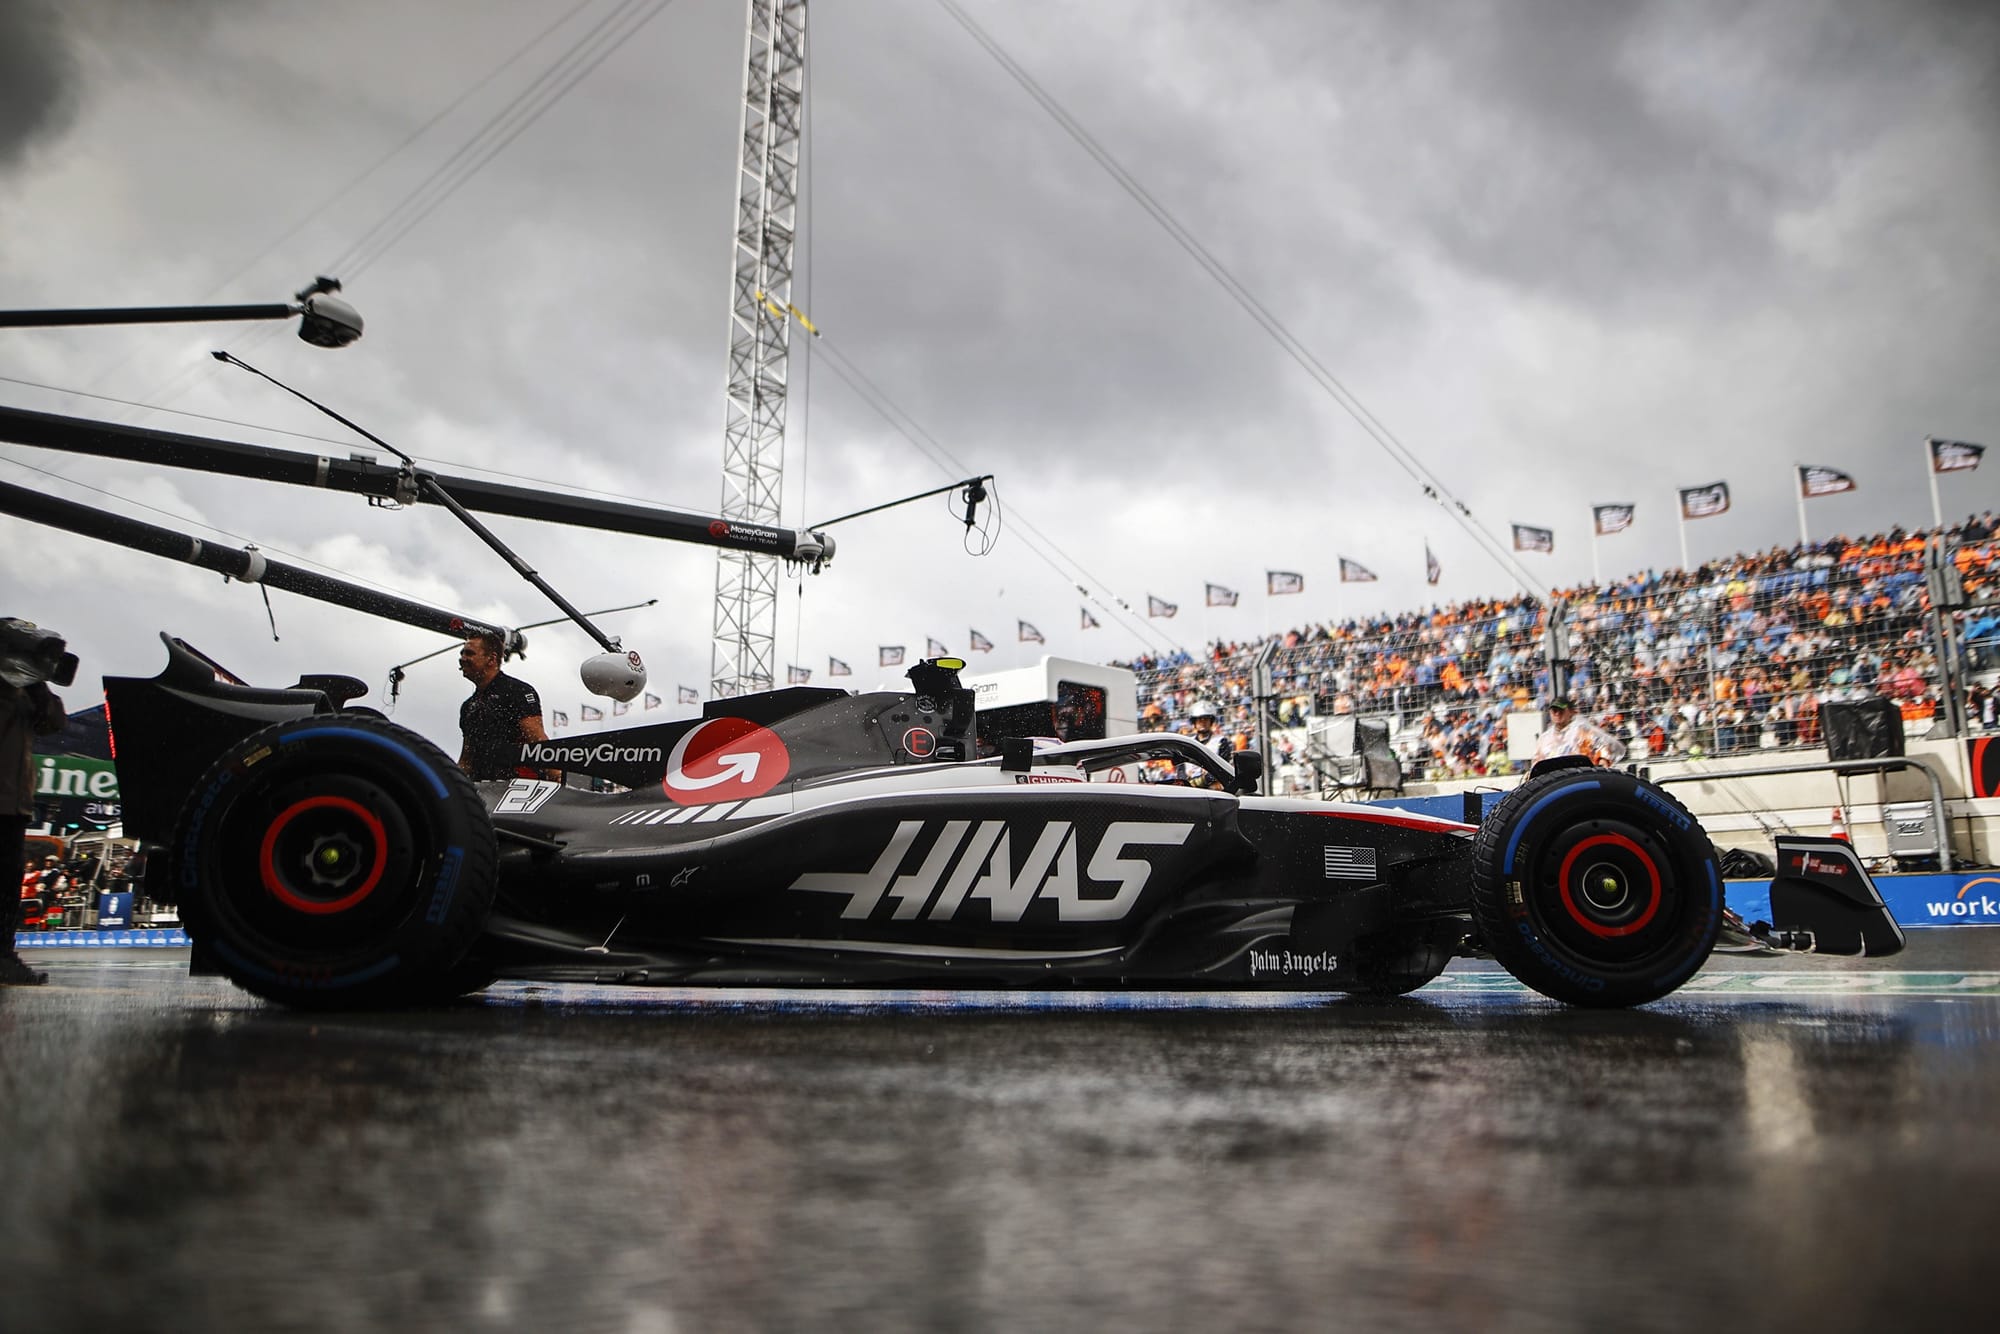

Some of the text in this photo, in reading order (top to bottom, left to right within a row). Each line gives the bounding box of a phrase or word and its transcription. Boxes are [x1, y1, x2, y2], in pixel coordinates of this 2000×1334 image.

[730, 524, 778, 539] MoneyGram
[911, 731, 928, 754] E
[520, 743, 662, 767] MoneyGram
[37, 758, 120, 799] ine
[1031, 776, 1074, 784] CHIPO
[493, 778, 562, 814] 27
[787, 820, 1196, 922] HAAS
[1926, 895, 2000, 917] work
[1250, 950, 1337, 977] Palm Angels
